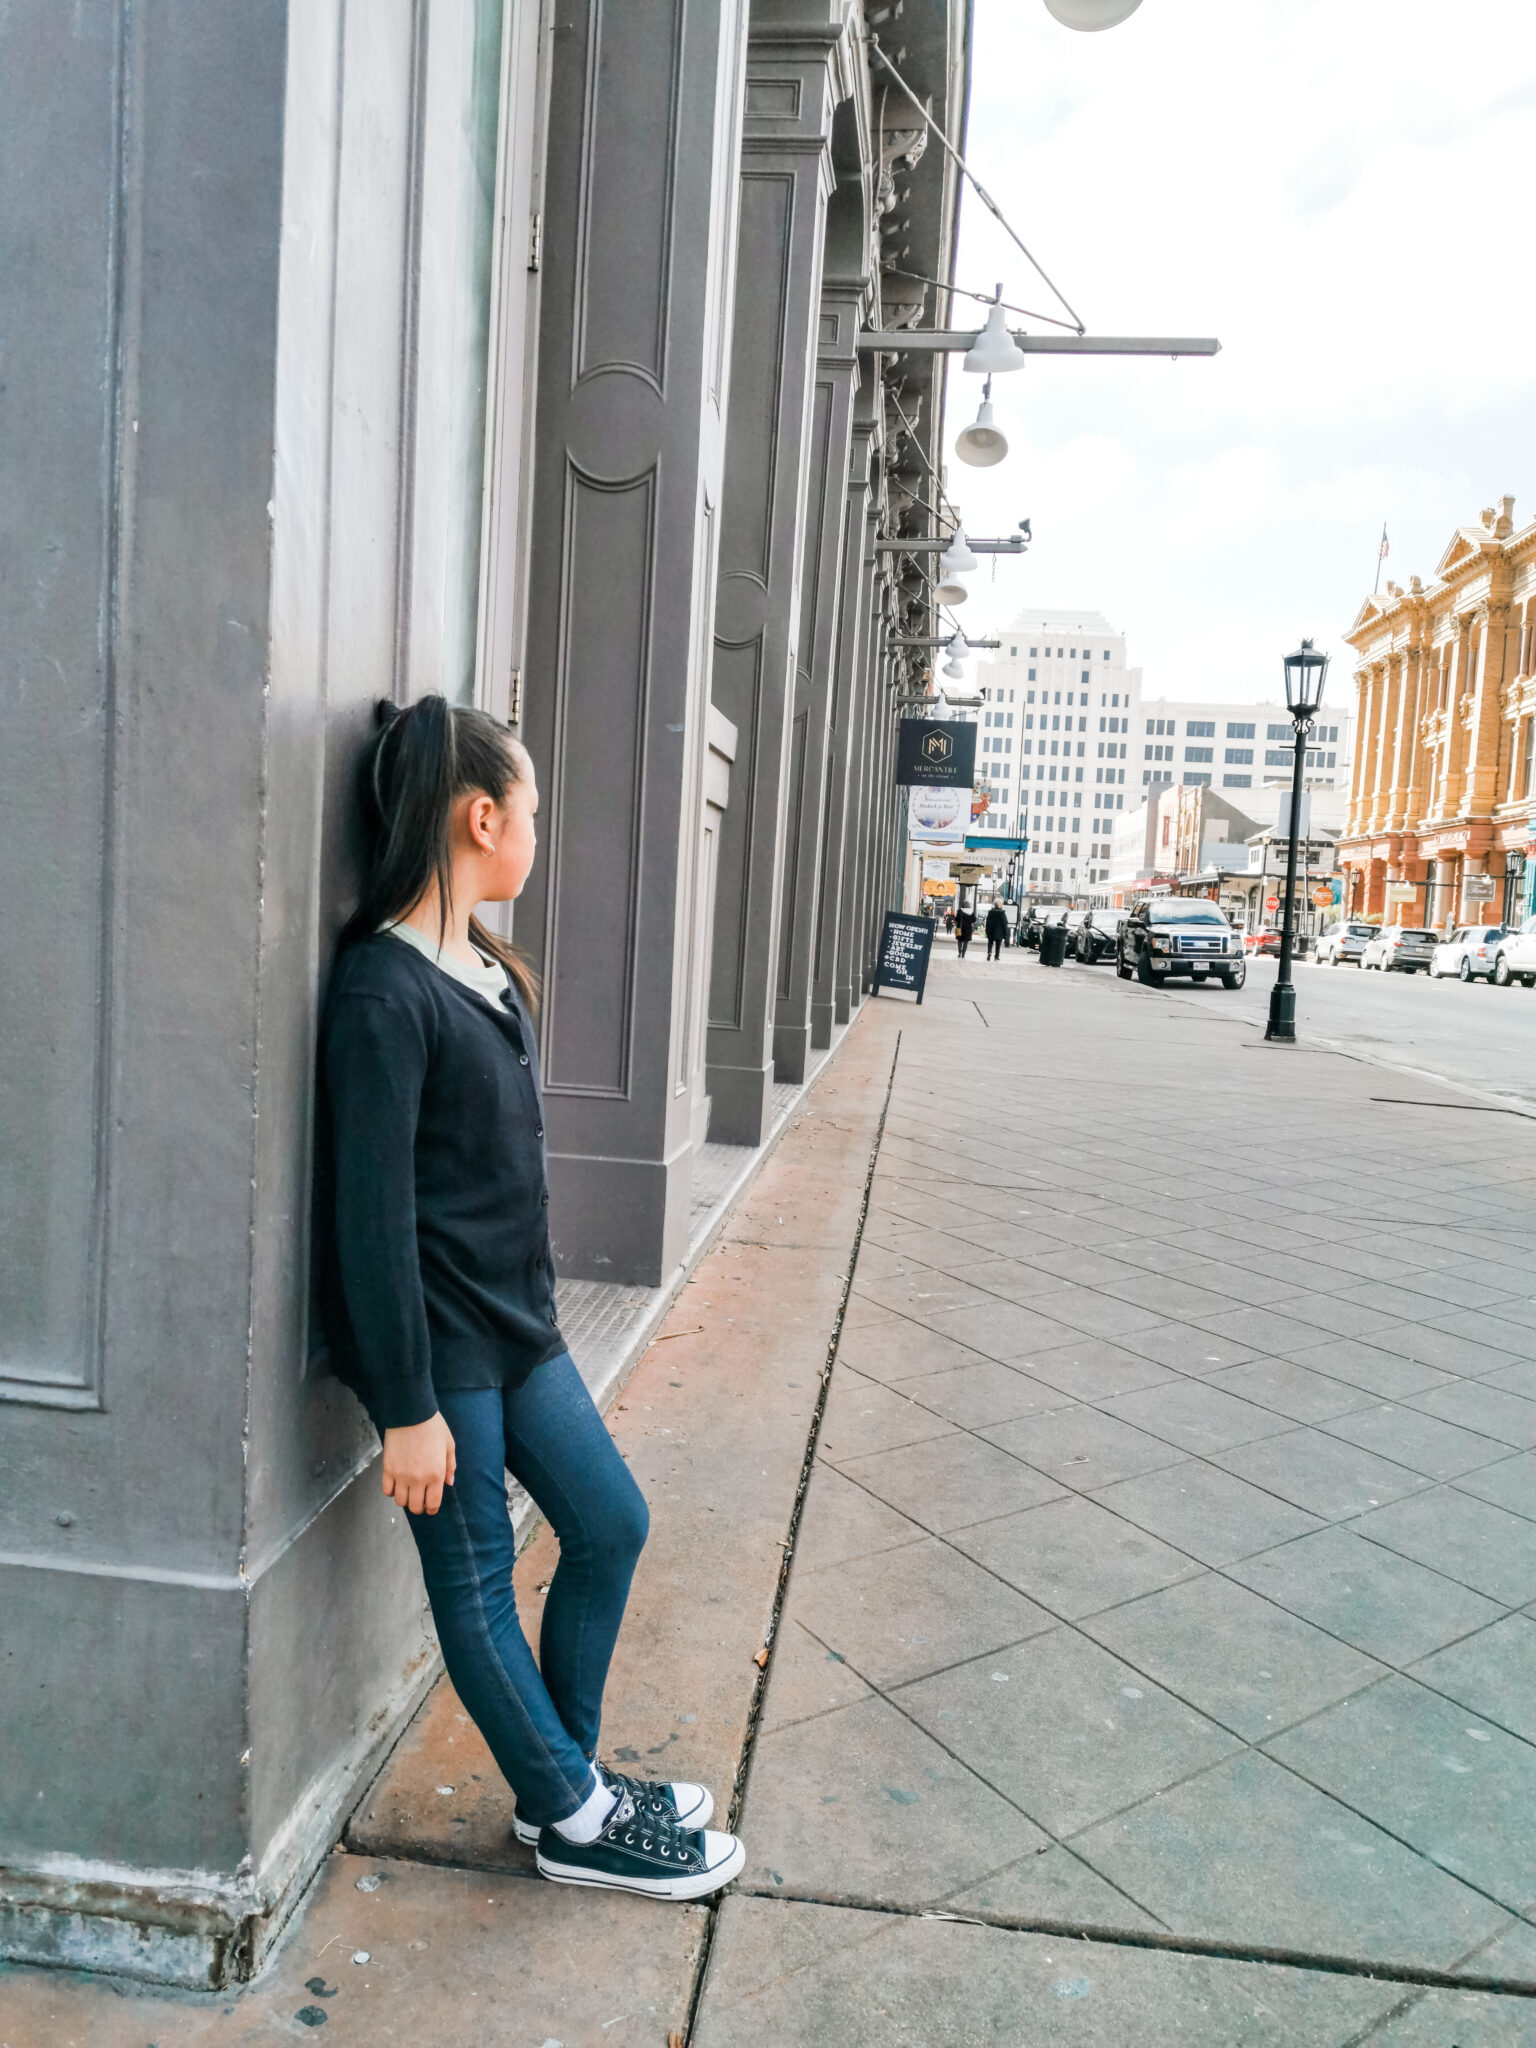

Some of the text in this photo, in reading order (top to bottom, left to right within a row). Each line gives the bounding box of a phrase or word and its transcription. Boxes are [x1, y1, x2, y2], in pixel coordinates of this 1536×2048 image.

[888, 922, 906, 930] NOW
[893, 929, 915, 938] HOME
[892, 935, 914, 944] GIFTS
[891, 940, 923, 951] JEWELRY
[889, 950, 915, 959] GOODS
[884, 961, 907, 970] COME
